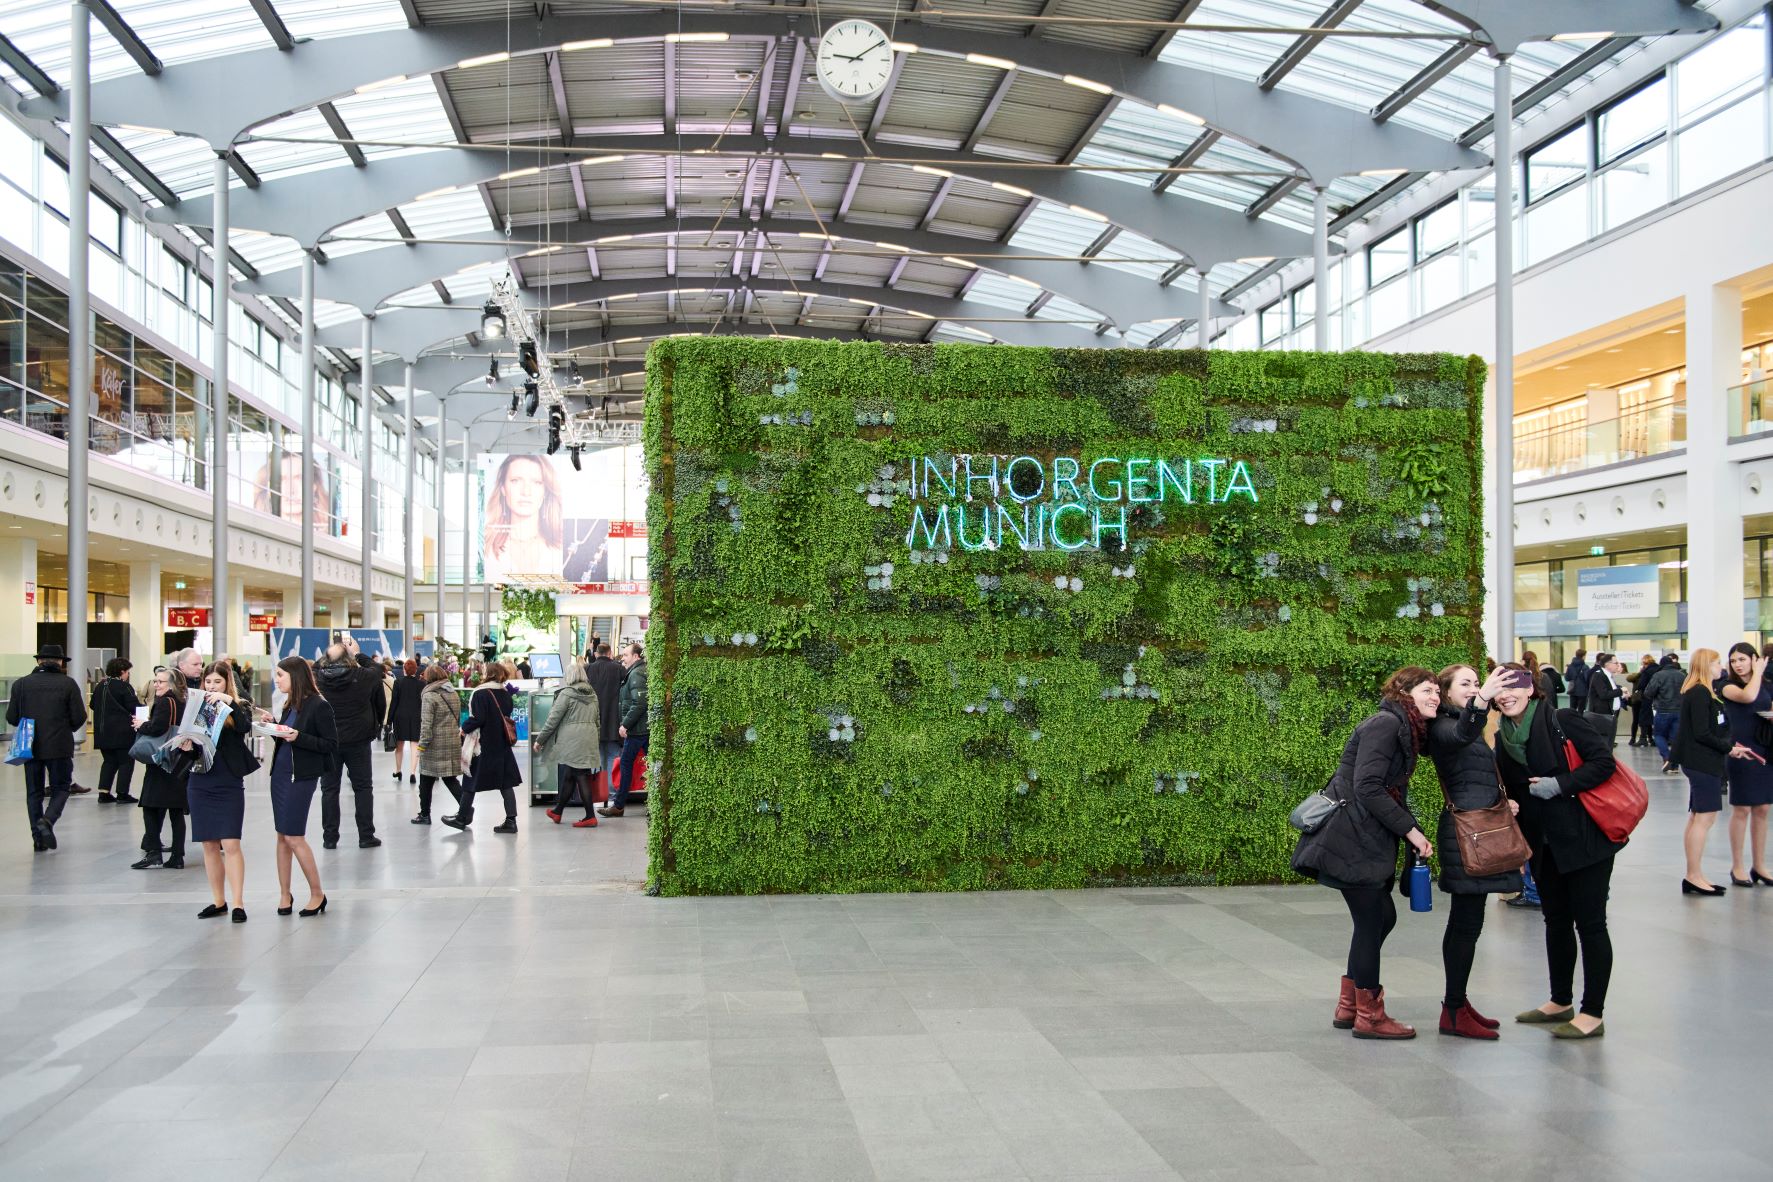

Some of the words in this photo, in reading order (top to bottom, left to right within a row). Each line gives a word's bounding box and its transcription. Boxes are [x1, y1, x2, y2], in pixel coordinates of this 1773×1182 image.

[912, 456, 1258, 502] INHORGENTA
[909, 503, 1126, 550] MUNICH
[177, 616, 188, 626] B,
[192, 616, 199, 625] C
